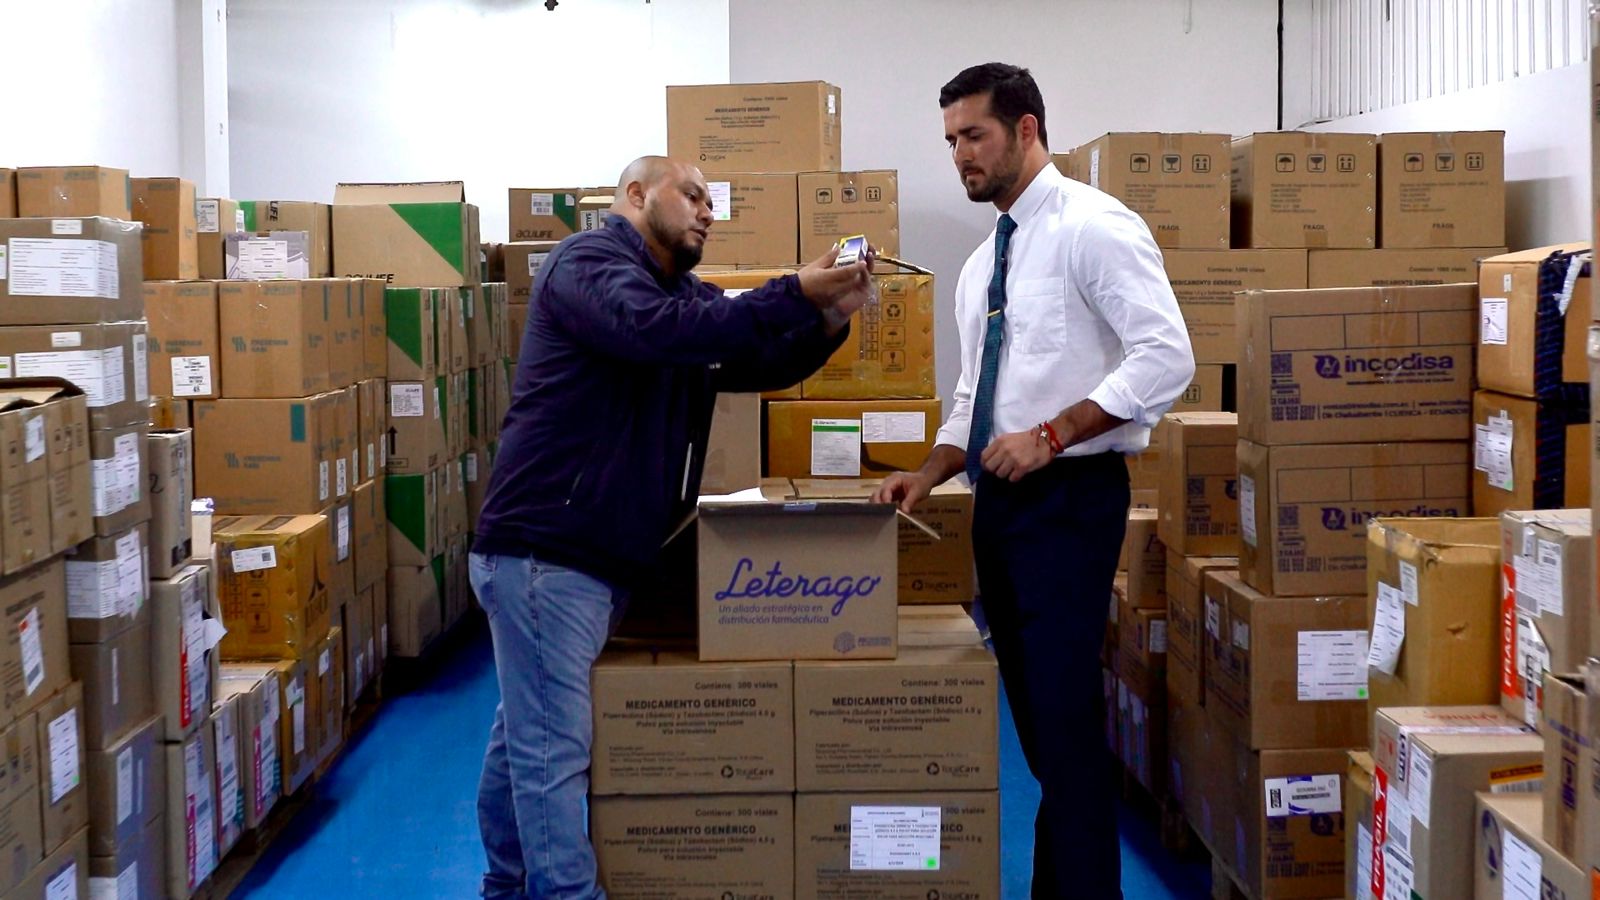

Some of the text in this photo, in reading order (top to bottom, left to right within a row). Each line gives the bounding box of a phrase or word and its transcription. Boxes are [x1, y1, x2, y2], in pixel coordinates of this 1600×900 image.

[1344, 352, 1454, 372] incodisa
[714, 557, 882, 616] Leterago
[625, 700, 701, 710] MEDICAMENTO
[832, 696, 908, 706] MEDICAMENTO
[626, 826, 701, 836] MEDICAMENTO
